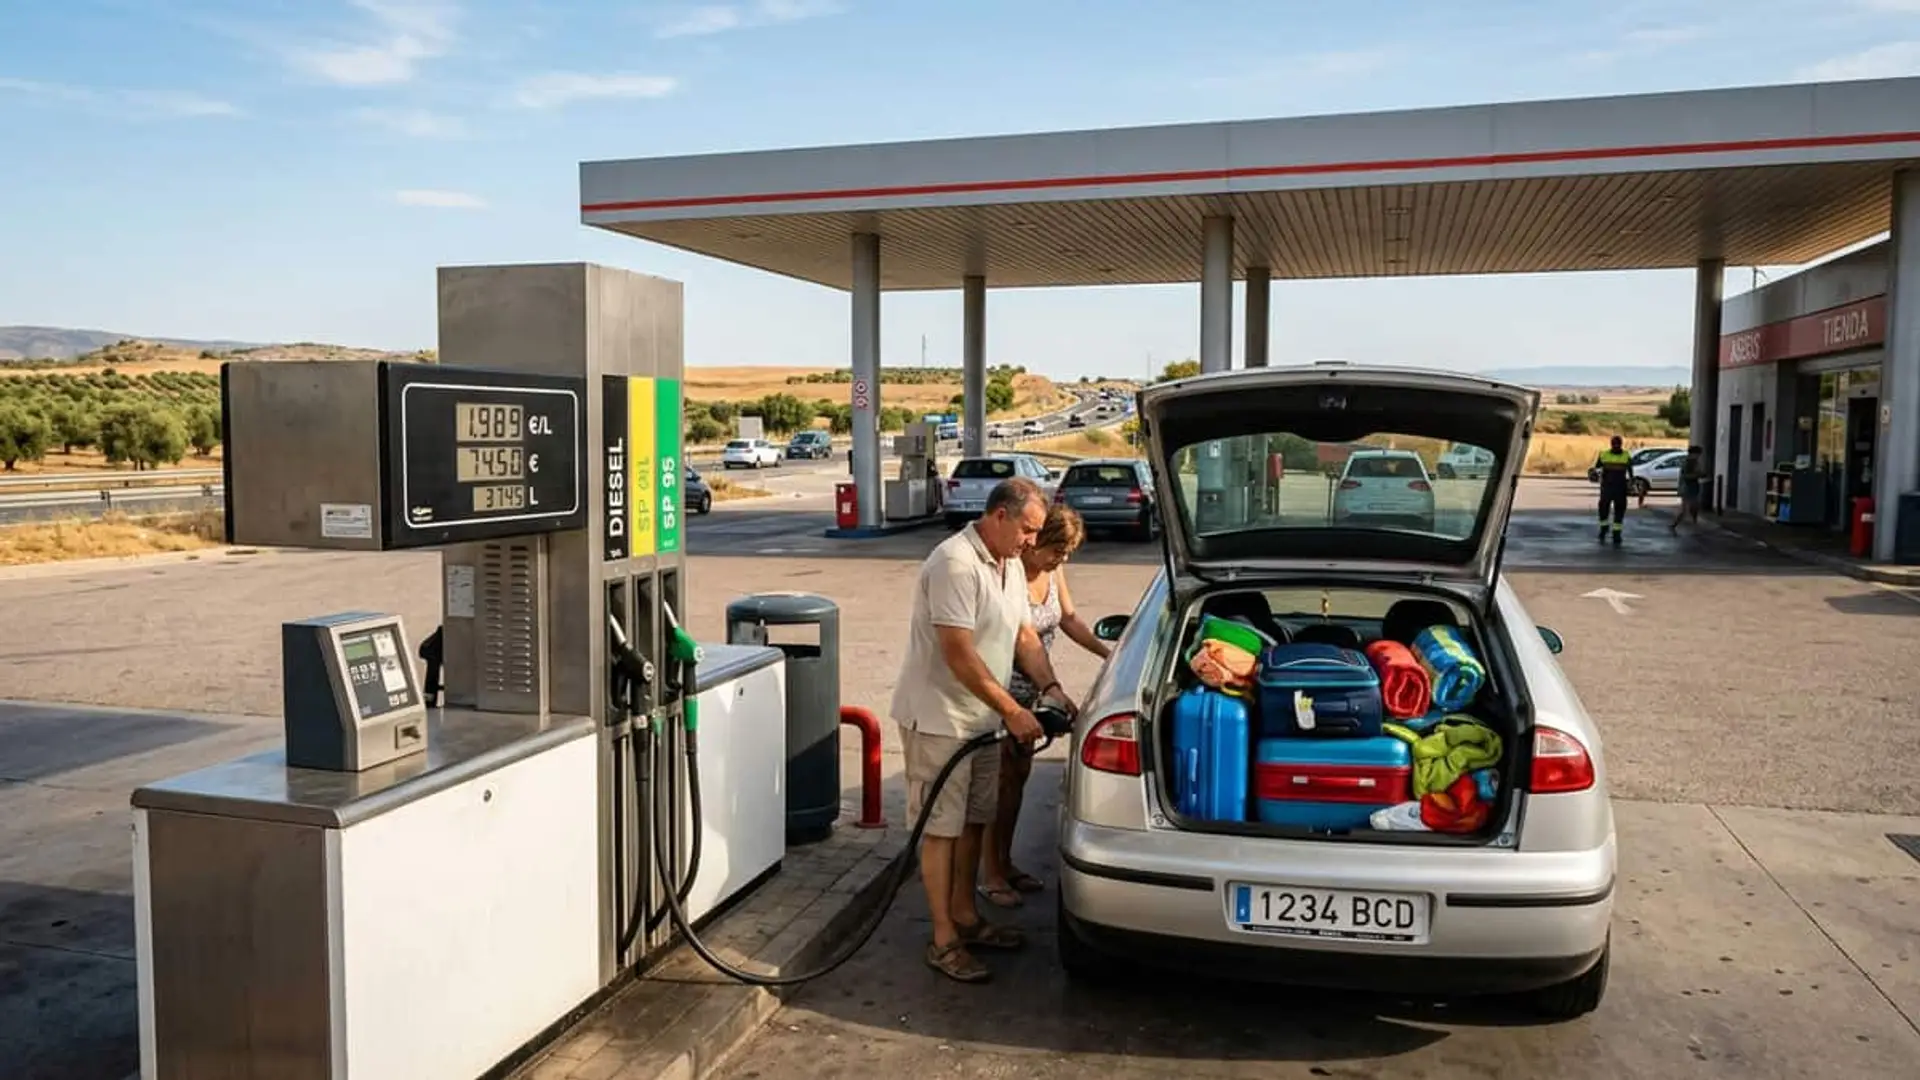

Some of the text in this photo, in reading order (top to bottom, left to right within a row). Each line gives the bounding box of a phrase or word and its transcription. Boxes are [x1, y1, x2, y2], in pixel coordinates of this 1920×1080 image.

[1825, 309, 1868, 346] TIENDA
[529, 415, 553, 435] €/L
[529, 453, 539, 473] €
[662, 456, 674, 487] 95
[529, 486, 539, 505] L
[609, 438, 623, 536] DIESEL
[663, 496, 674, 529] SP
[1261, 891, 1414, 929] 1234 BCD
